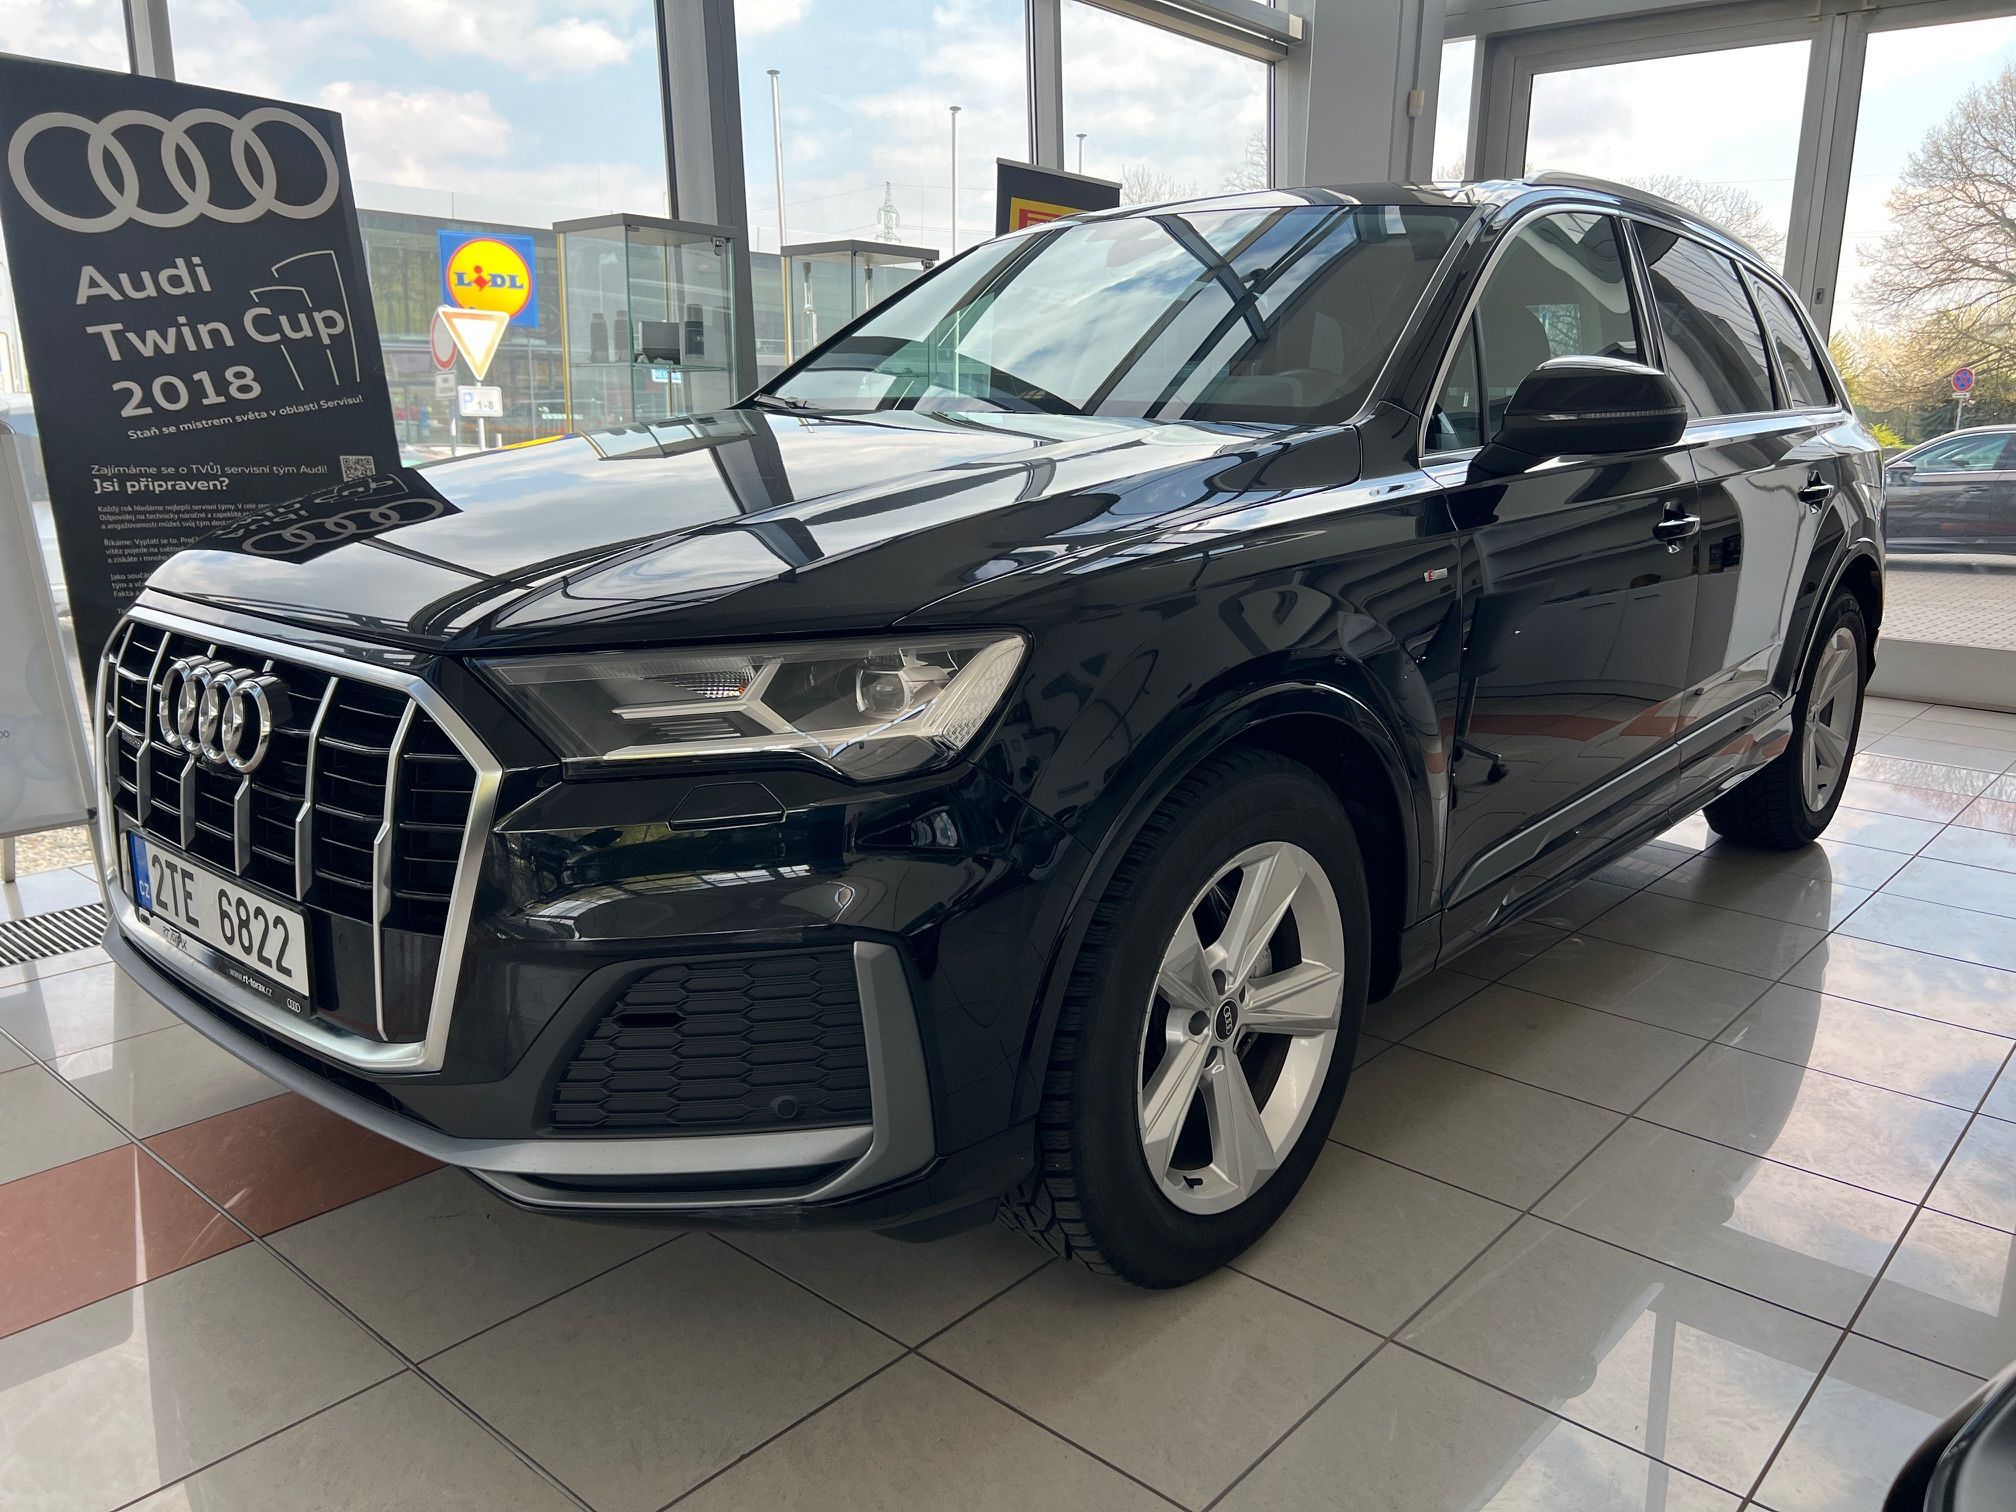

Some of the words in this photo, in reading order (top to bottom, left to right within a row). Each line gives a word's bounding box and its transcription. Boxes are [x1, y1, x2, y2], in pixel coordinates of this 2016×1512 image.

[75, 256, 212, 305] Audi
[85, 315, 235, 361] Twin
[243, 307, 345, 345] Cup
[111, 365, 262, 418] 2018
[127, 428, 160, 440] Staň
[162, 425, 177, 435] se
[179, 415, 233, 431] mistrem
[235, 410, 268, 423] světa
[269, 409, 277, 417] v
[279, 401, 319, 416] oblasti
[319, 394, 363, 410] Servisu!
[90, 464, 157, 477] Zajímáme
[161, 466, 176, 474] se
[179, 466, 187, 474] o
[190, 462, 221, 475] TVŮJ
[224, 464, 270, 474] servisní
[273, 464, 297, 476] tým
[300, 465, 328, 474] Audi!
[93, 478, 119, 494] Jsi
[126, 477, 230, 494] připraven?
[138, 880, 150, 899] CZ
[151, 854, 200, 929] 2TE
[217, 888, 293, 979] 6822
[229, 967, 273, 997] www.rt-torax.cz
